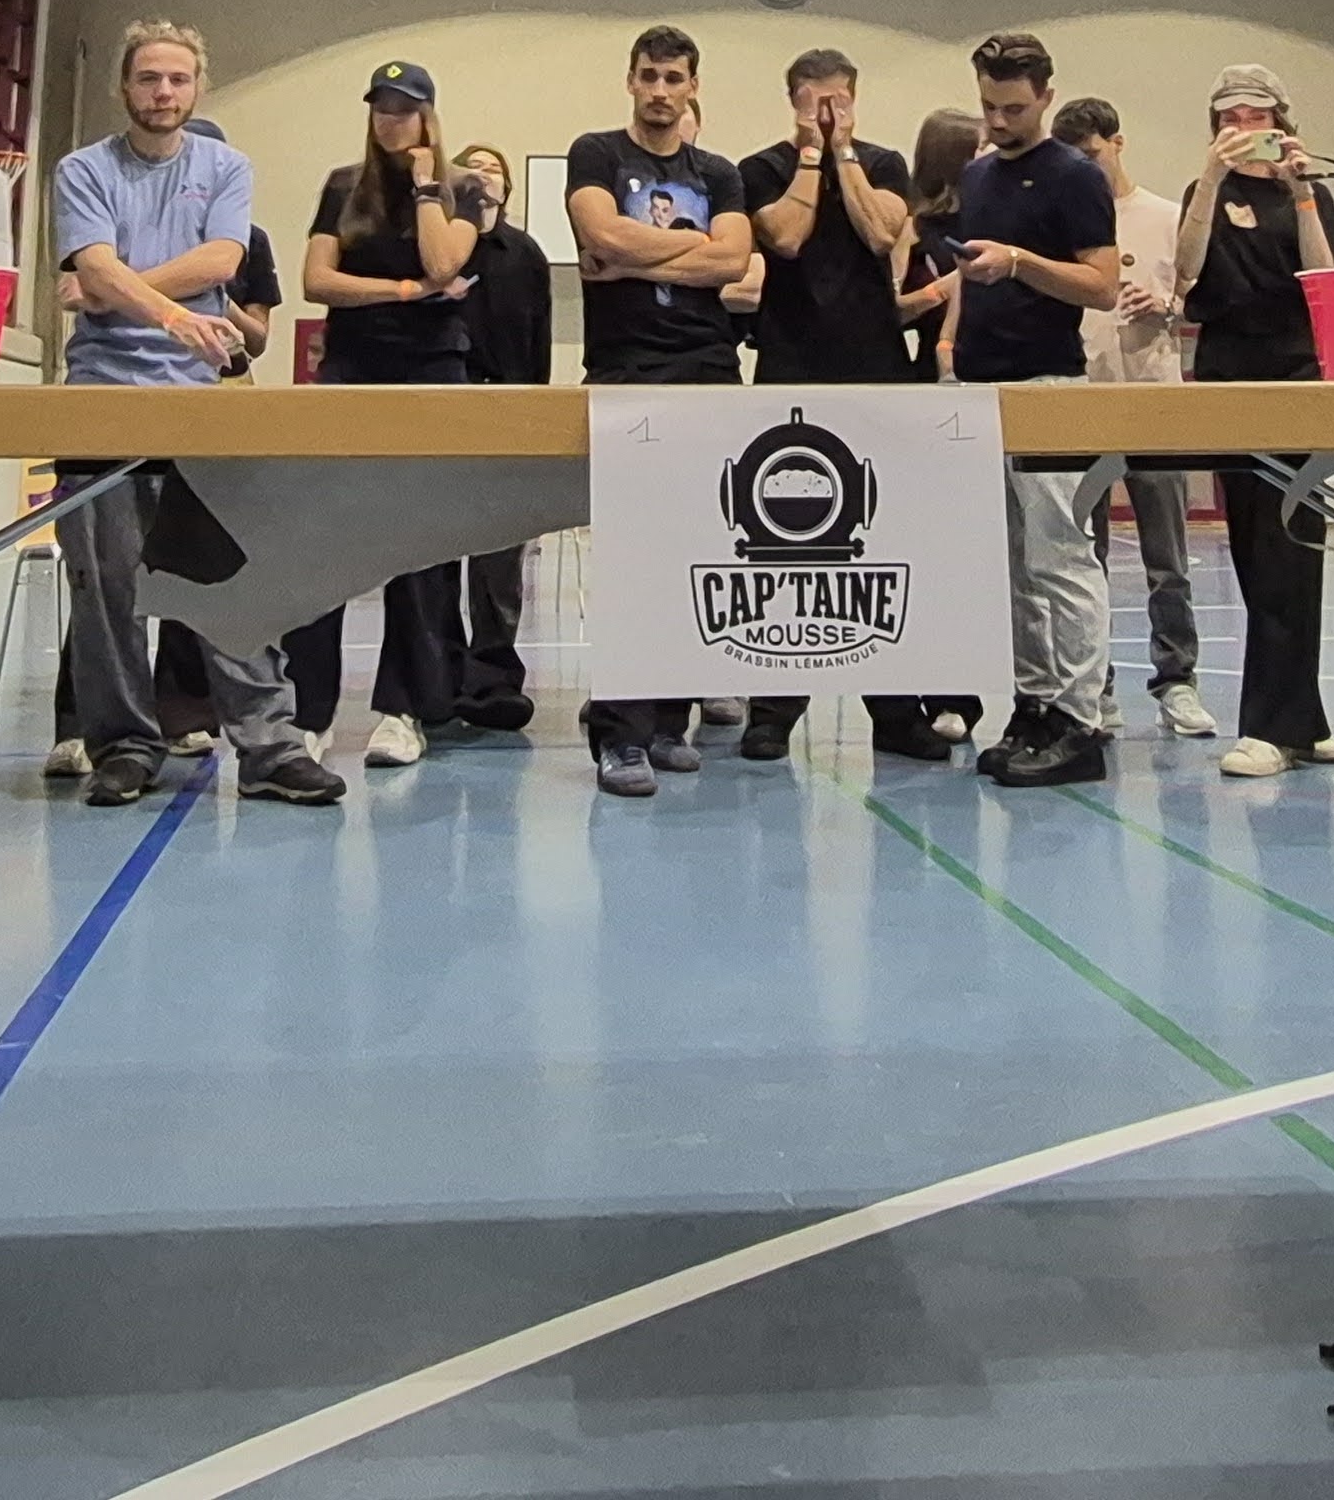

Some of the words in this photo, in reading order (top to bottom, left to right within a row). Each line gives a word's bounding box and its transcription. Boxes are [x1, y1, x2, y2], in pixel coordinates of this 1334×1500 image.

[627, 417, 660, 443] 1
[936, 412, 977, 440] 1
[703, 572, 897, 633] CAP'TAINE
[746, 624, 856, 646] MOUSSE
[724, 644, 788, 668] BRASSIN
[795, 643, 878, 669] LÉMANIQUE
